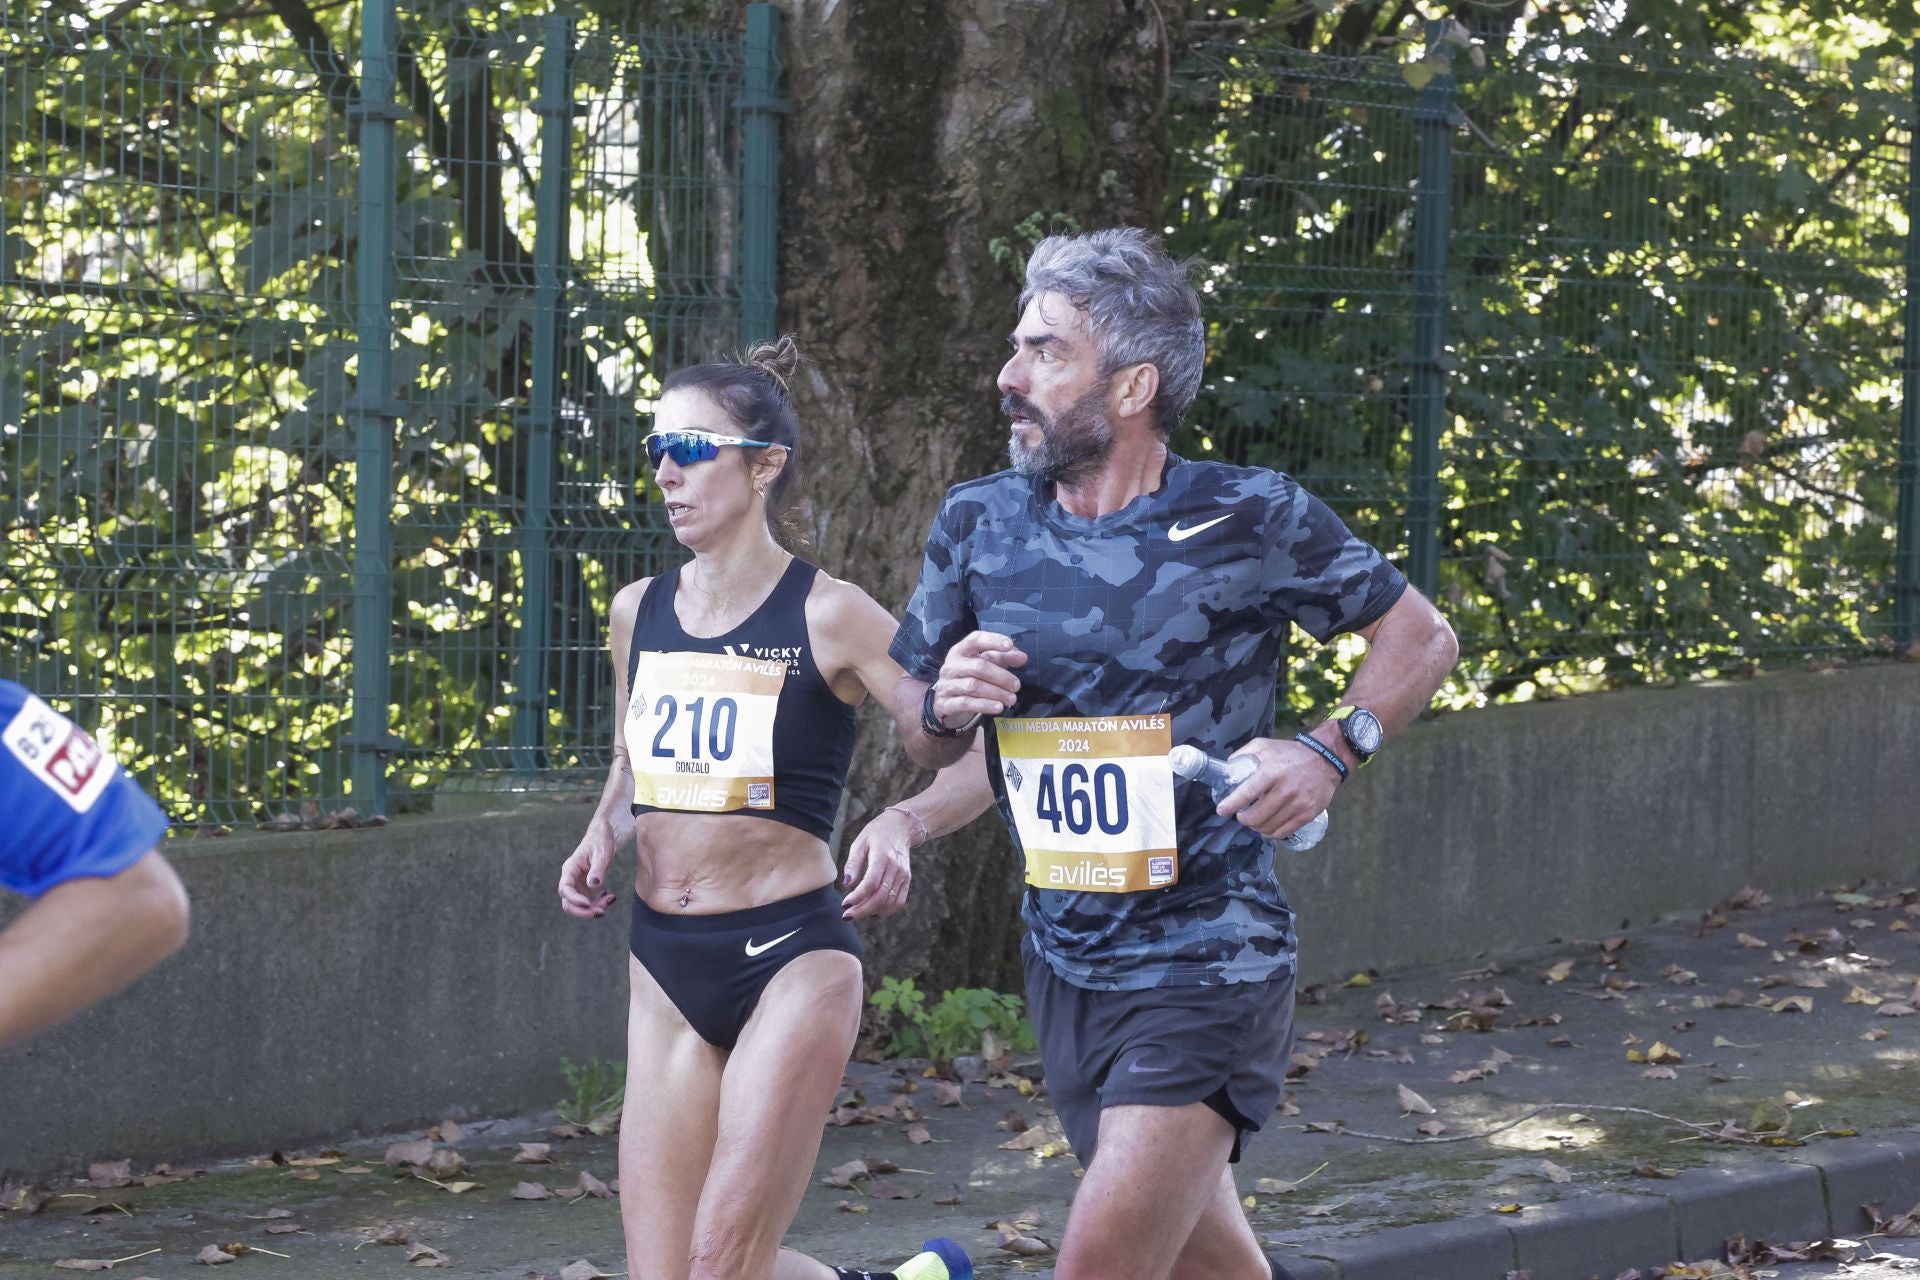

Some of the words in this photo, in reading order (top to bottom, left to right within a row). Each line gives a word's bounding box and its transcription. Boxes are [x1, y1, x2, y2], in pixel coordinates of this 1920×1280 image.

[754, 647, 801, 658] VICKY
[652, 695, 737, 761] 210
[1026, 721, 1061, 732] MEDIA
[1063, 718, 1118, 733] MARATÓN
[1120, 716, 1165, 731] AVILÉS
[1058, 739, 1090, 752] 2024
[675, 762, 710, 774] GONZALO
[1036, 763, 1129, 835] 460
